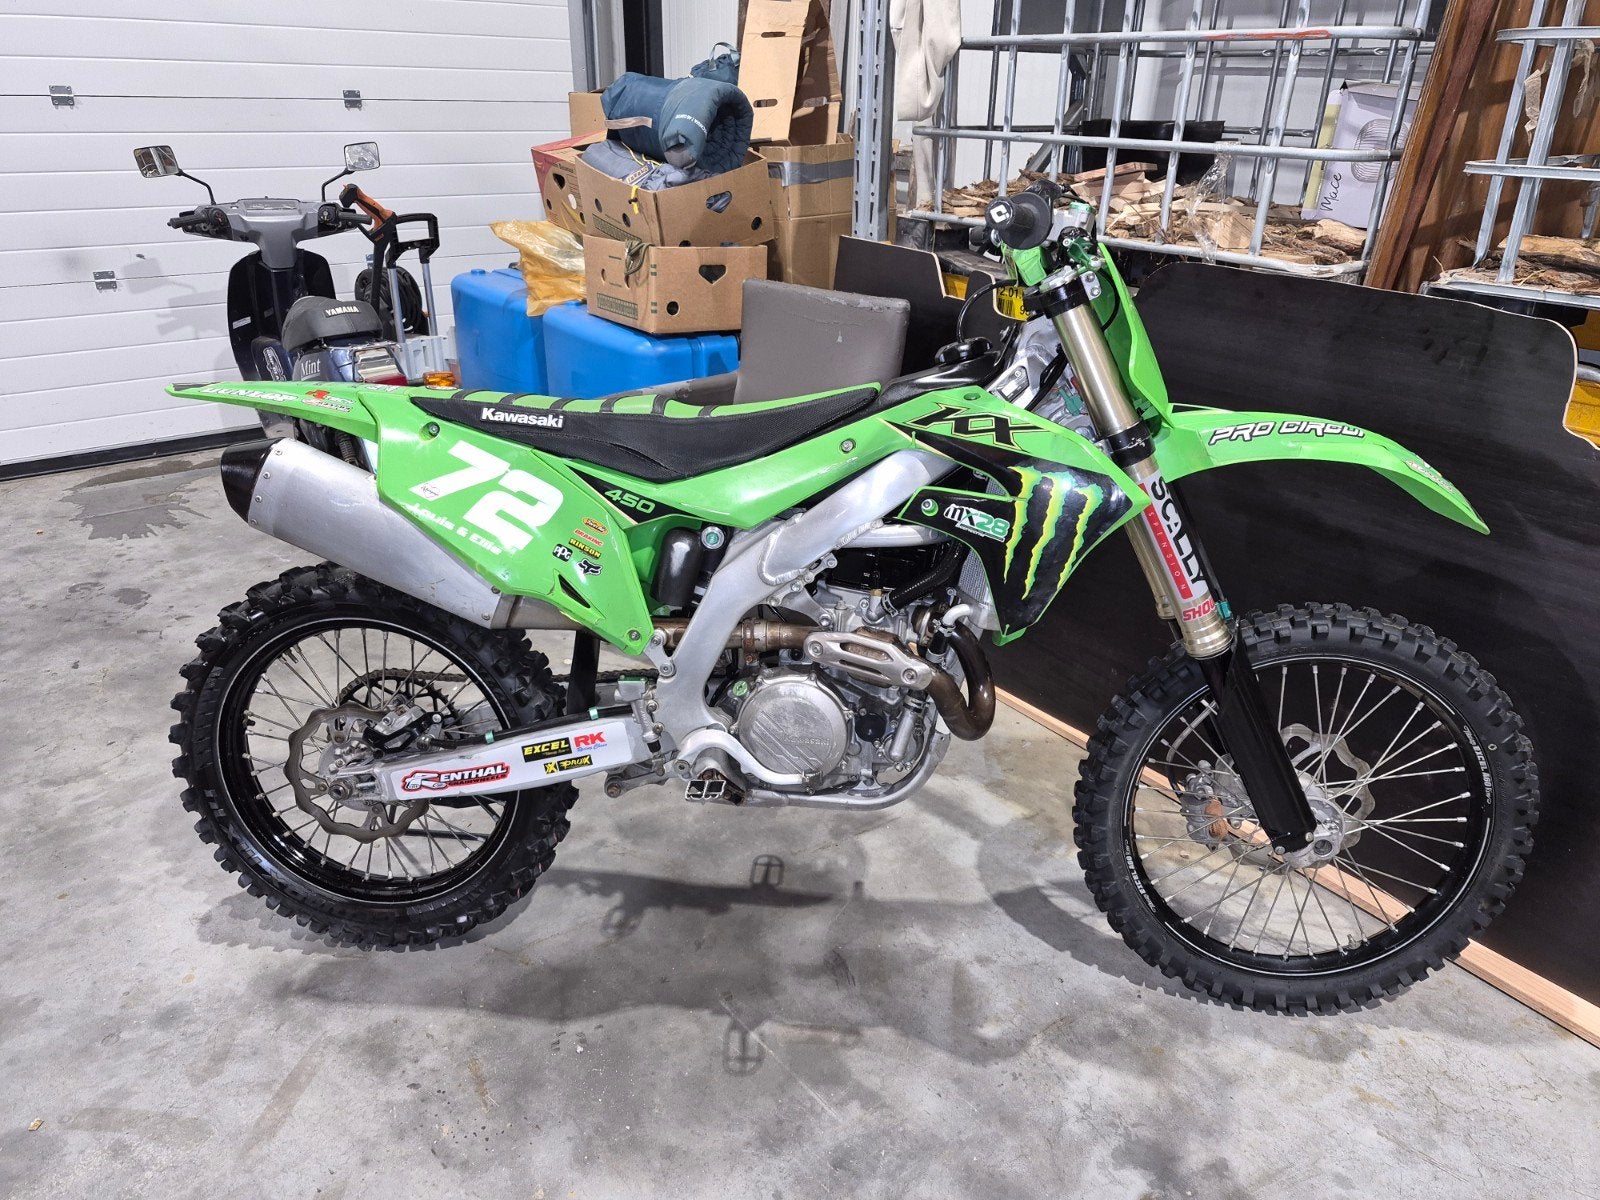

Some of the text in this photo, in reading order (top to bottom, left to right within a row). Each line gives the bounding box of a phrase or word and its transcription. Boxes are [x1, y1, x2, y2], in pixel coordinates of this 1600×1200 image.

[1319, 173, 1342, 211] Mace
[325, 306, 360, 316] YAMAHA
[301, 358, 321, 375] Mint
[481, 407, 563, 429] Kawasaki
[1208, 421, 1276, 445] PRO
[408, 440, 563, 551] 72
[604, 489, 656, 514] 450
[1151, 476, 1207, 584] SCALLY
[524, 740, 569, 755] EXCEL
[574, 732, 605, 747] RK
[405, 765, 507, 790] RENTHAL
